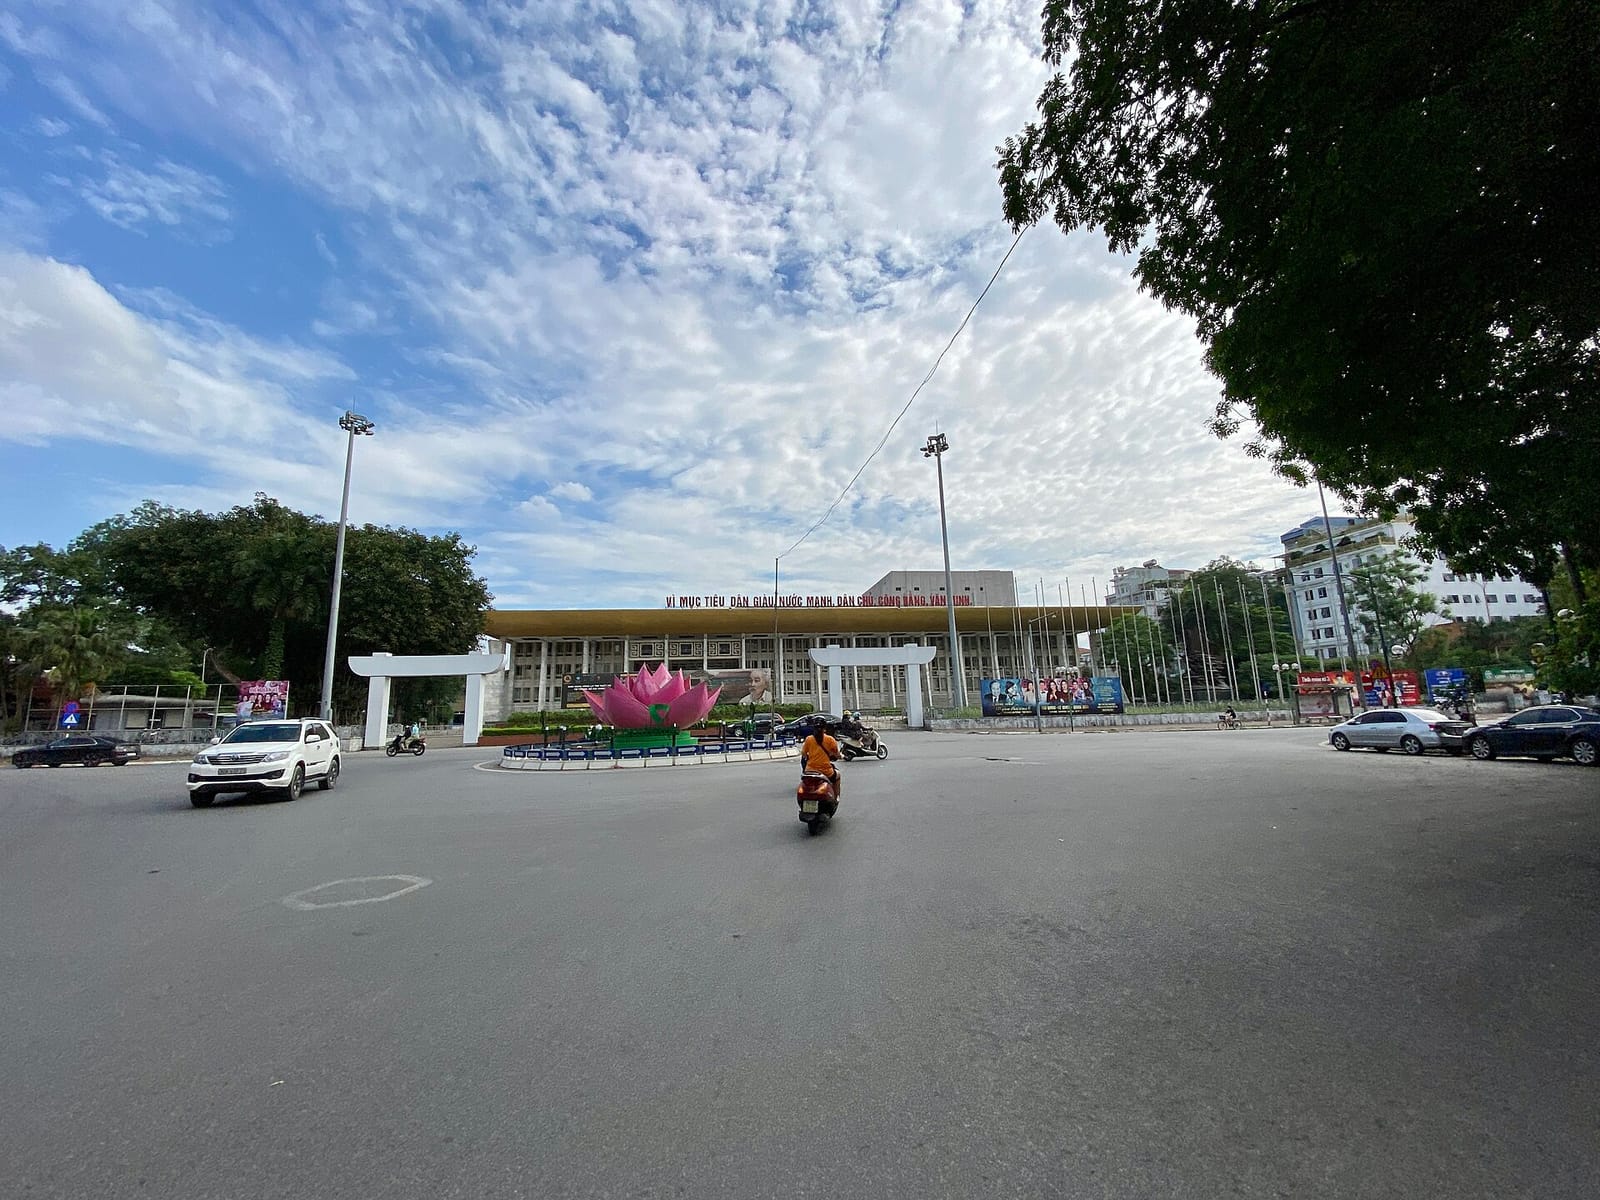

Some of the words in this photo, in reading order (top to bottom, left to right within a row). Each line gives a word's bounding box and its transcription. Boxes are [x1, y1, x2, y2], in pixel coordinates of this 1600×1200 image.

[666, 594, 675, 608] VÌ
[679, 596, 701, 609] MỤC
[704, 594, 725, 608] TIÊU
[730, 594, 749, 608] DÂN
[779, 593, 803, 607] NƯỚC
[837, 593, 855, 607] DÂN
